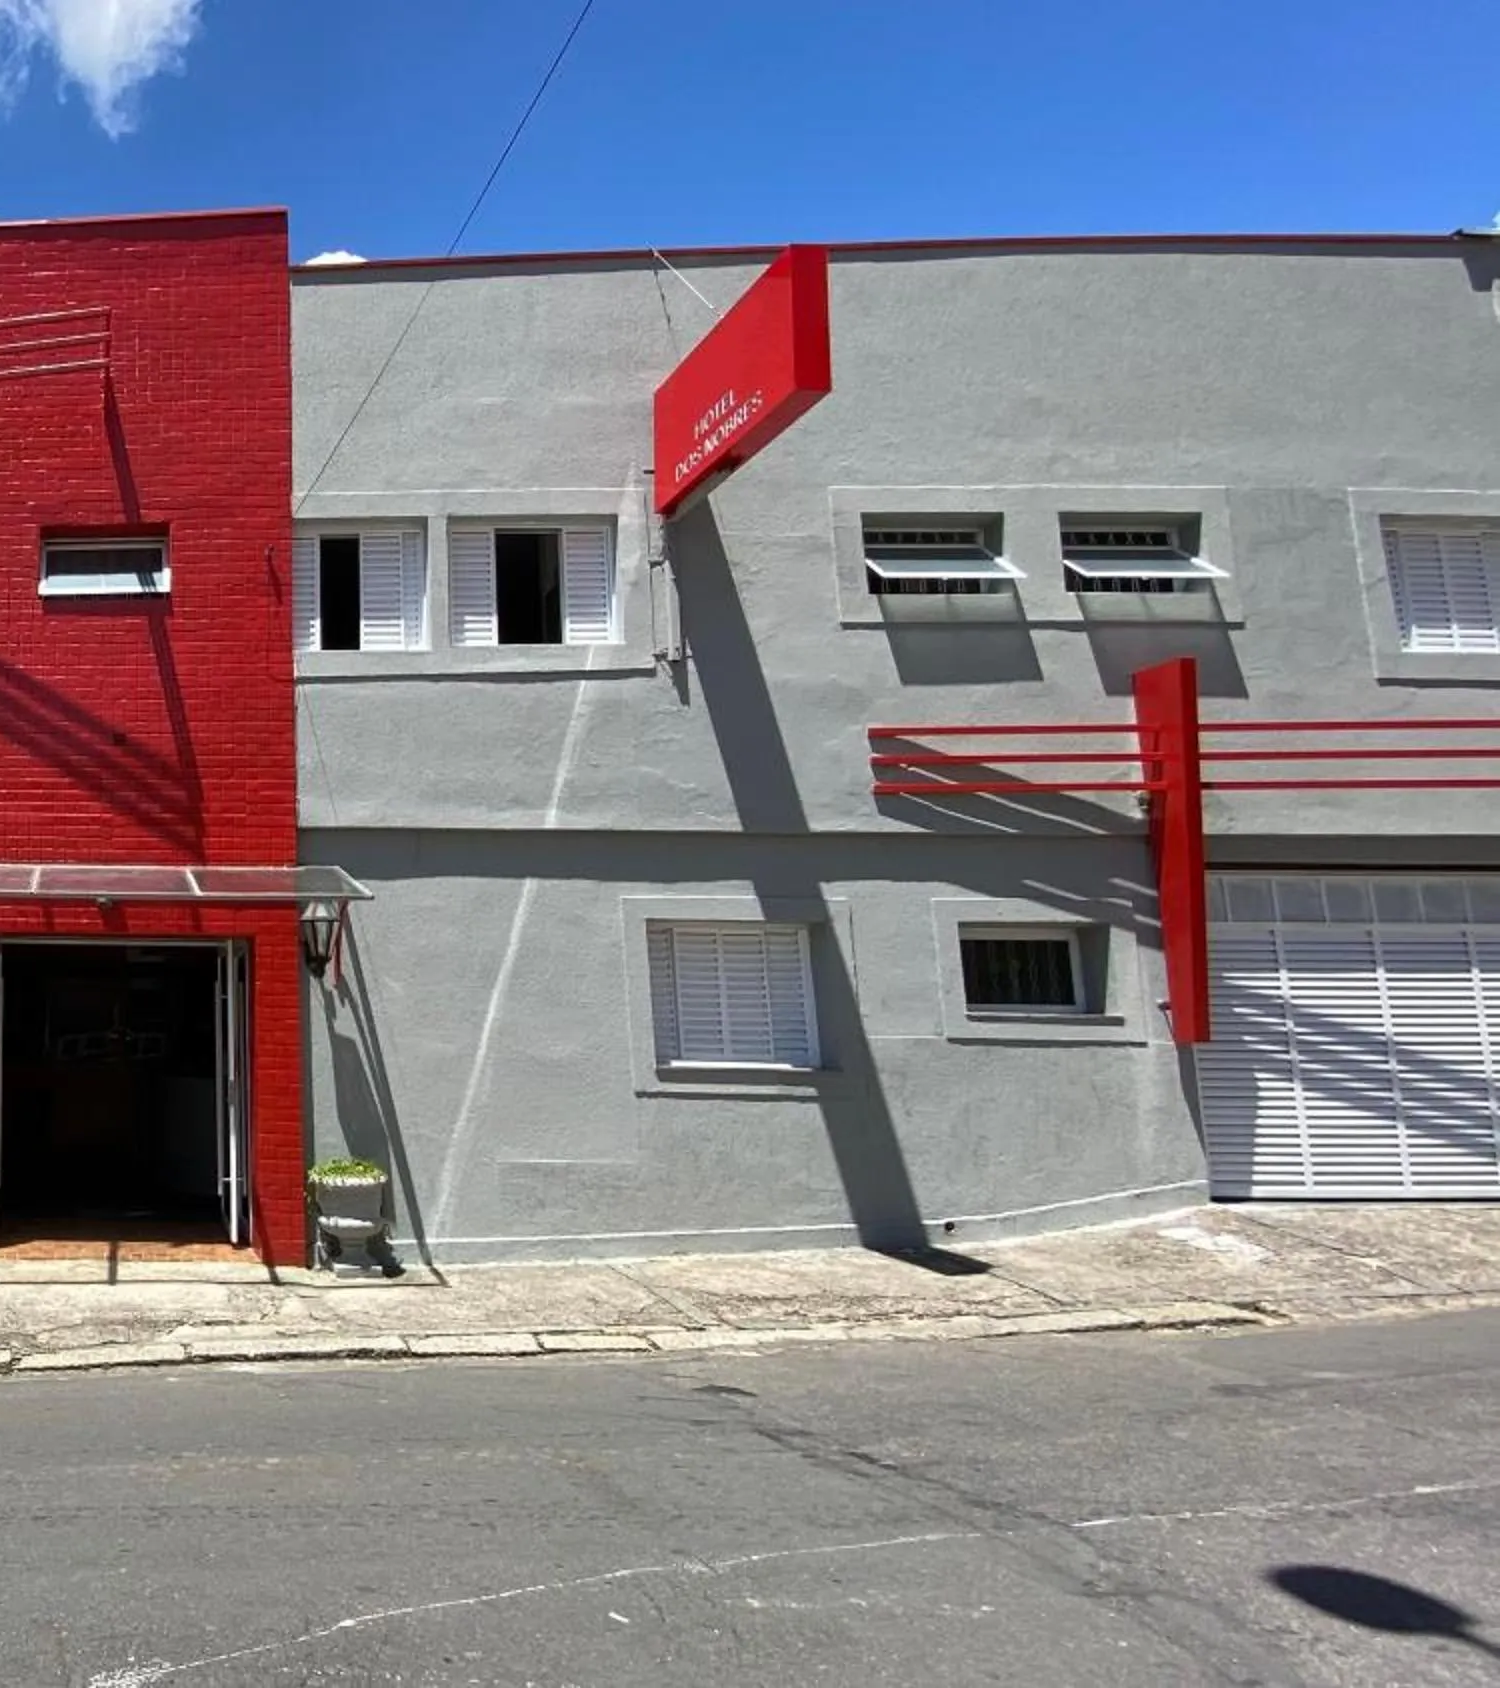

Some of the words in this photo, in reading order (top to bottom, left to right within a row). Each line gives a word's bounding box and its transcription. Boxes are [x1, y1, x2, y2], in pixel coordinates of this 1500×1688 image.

[675, 445, 702, 483] DOS
[703, 390, 762, 456] NOBRES
[694, 388, 736, 440] HOTEL
